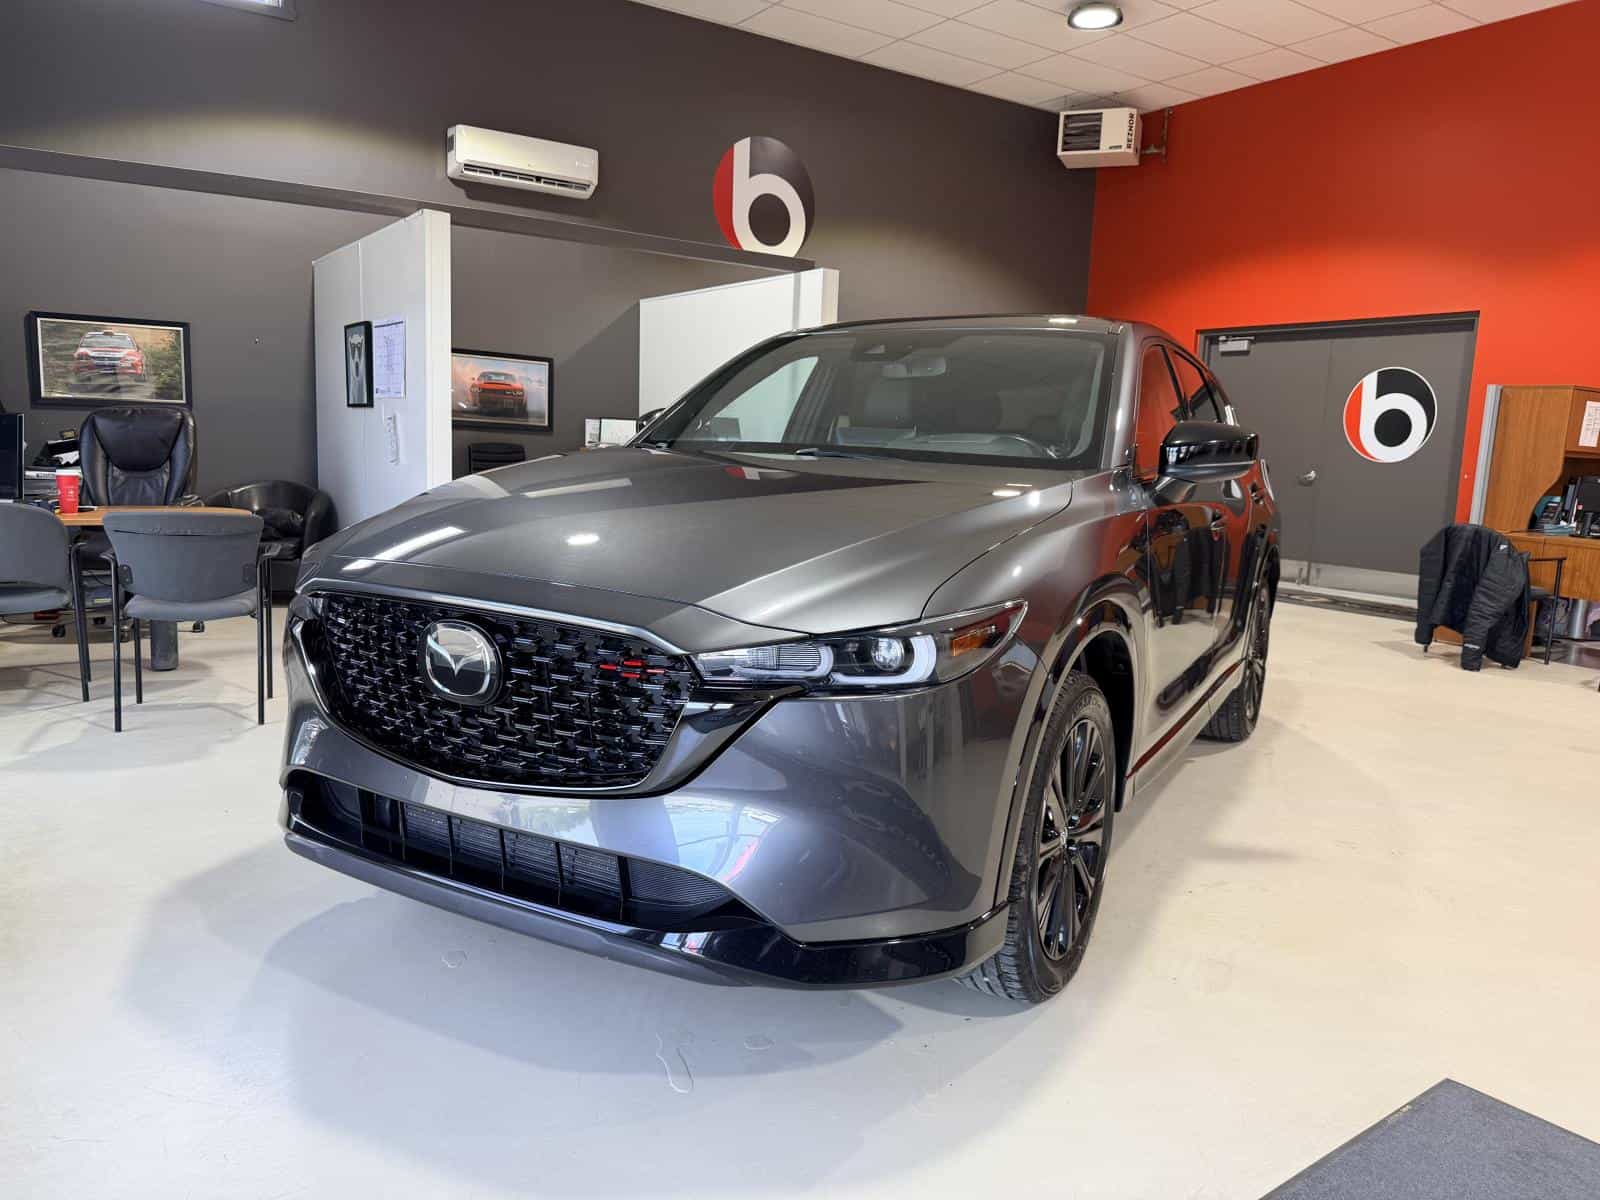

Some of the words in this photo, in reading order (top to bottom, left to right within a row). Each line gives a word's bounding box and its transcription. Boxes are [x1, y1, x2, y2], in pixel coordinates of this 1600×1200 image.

[1126, 112, 1135, 149] REZNOR
[732, 136, 806, 258] b
[1360, 369, 1427, 463] b
